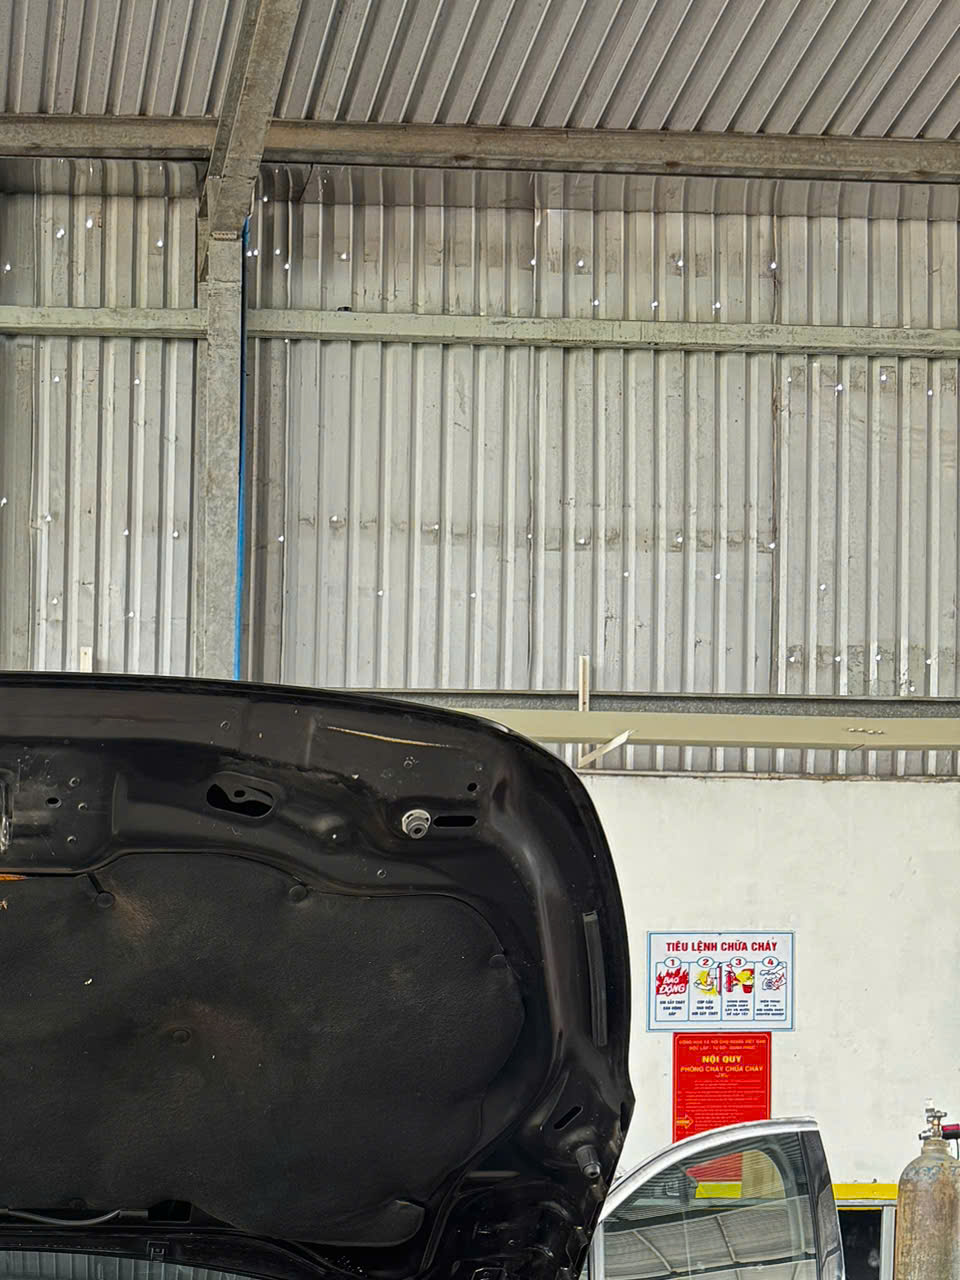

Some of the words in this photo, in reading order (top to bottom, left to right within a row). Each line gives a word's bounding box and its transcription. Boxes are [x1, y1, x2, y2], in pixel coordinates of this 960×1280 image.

[666, 940, 688, 952] TIÊU
[691, 940, 717, 954] LỆNH
[720, 939, 748, 952] CHỮA
[751, 940, 778, 952] CHÁY
[722, 1055, 741, 1064] QUY
